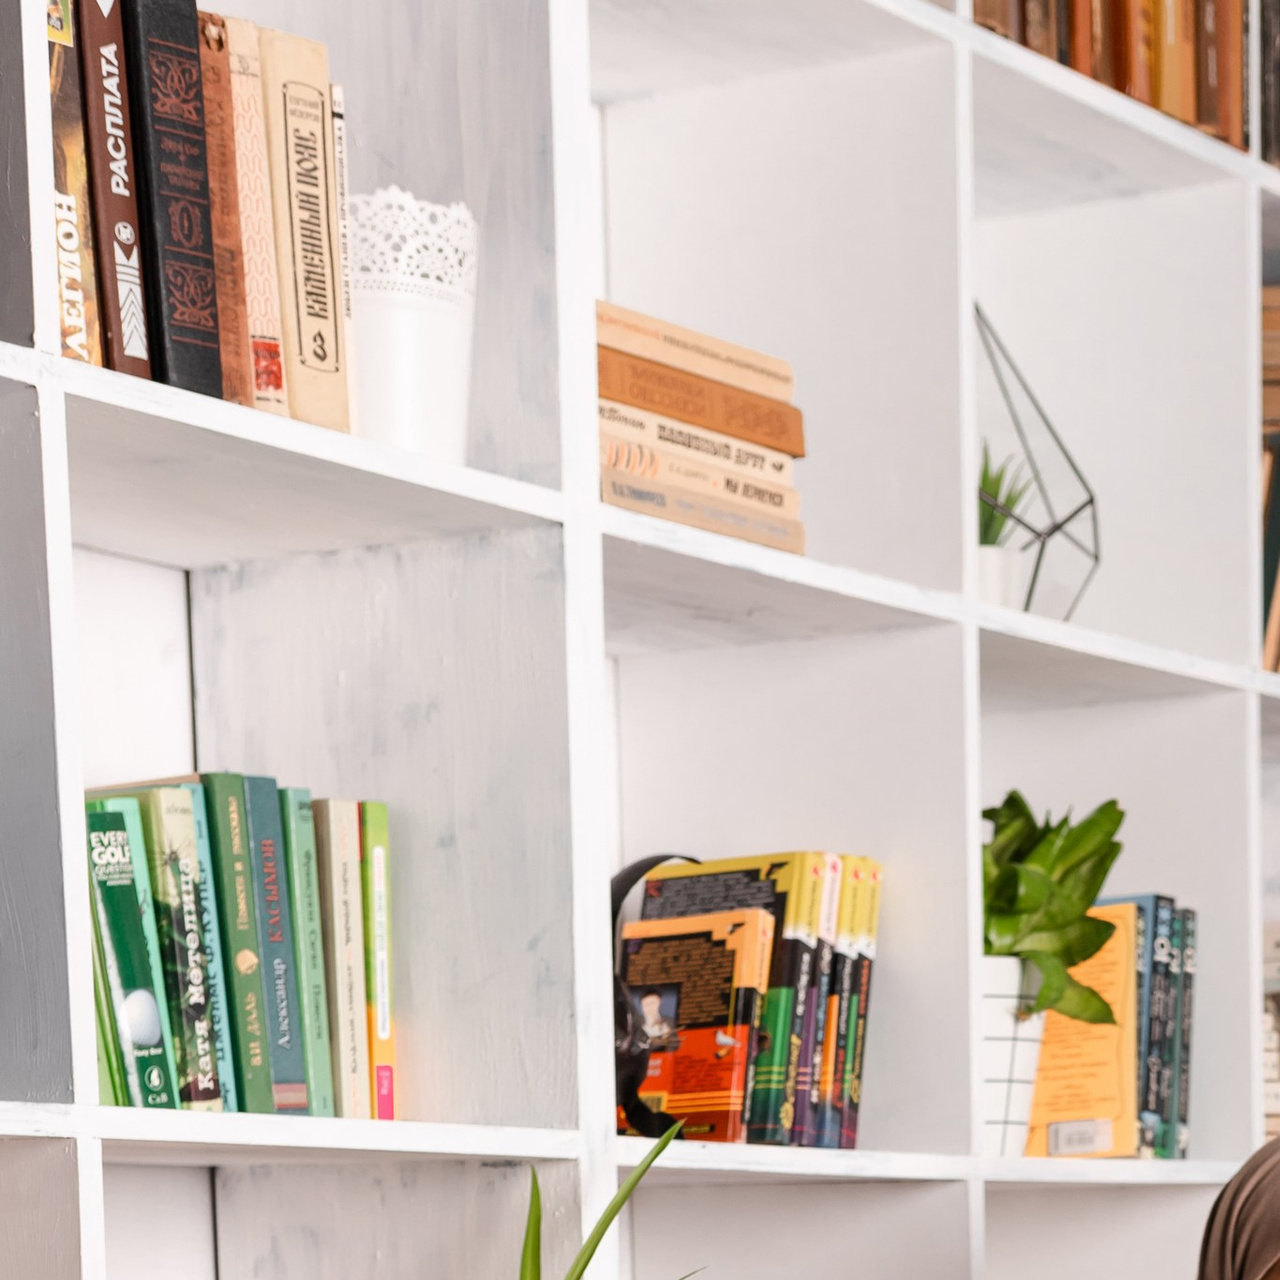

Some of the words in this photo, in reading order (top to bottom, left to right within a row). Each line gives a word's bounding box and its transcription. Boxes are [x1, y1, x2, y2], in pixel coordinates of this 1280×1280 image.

[98, 43, 130, 197] РАСПЛАТА
[293, 128, 318, 188] ПОЯС
[55, 193, 90, 361] ЛЕГИОН
[296, 188, 328, 320] КАМЕННЫЙ
[90, 830, 128, 848] EVER
[260, 839, 285, 944] КАСЫМОВ
[178, 857, 208, 1006] Метелица
[193, 1018, 214, 1091] Катя
[272, 957, 292, 1051] Александр
